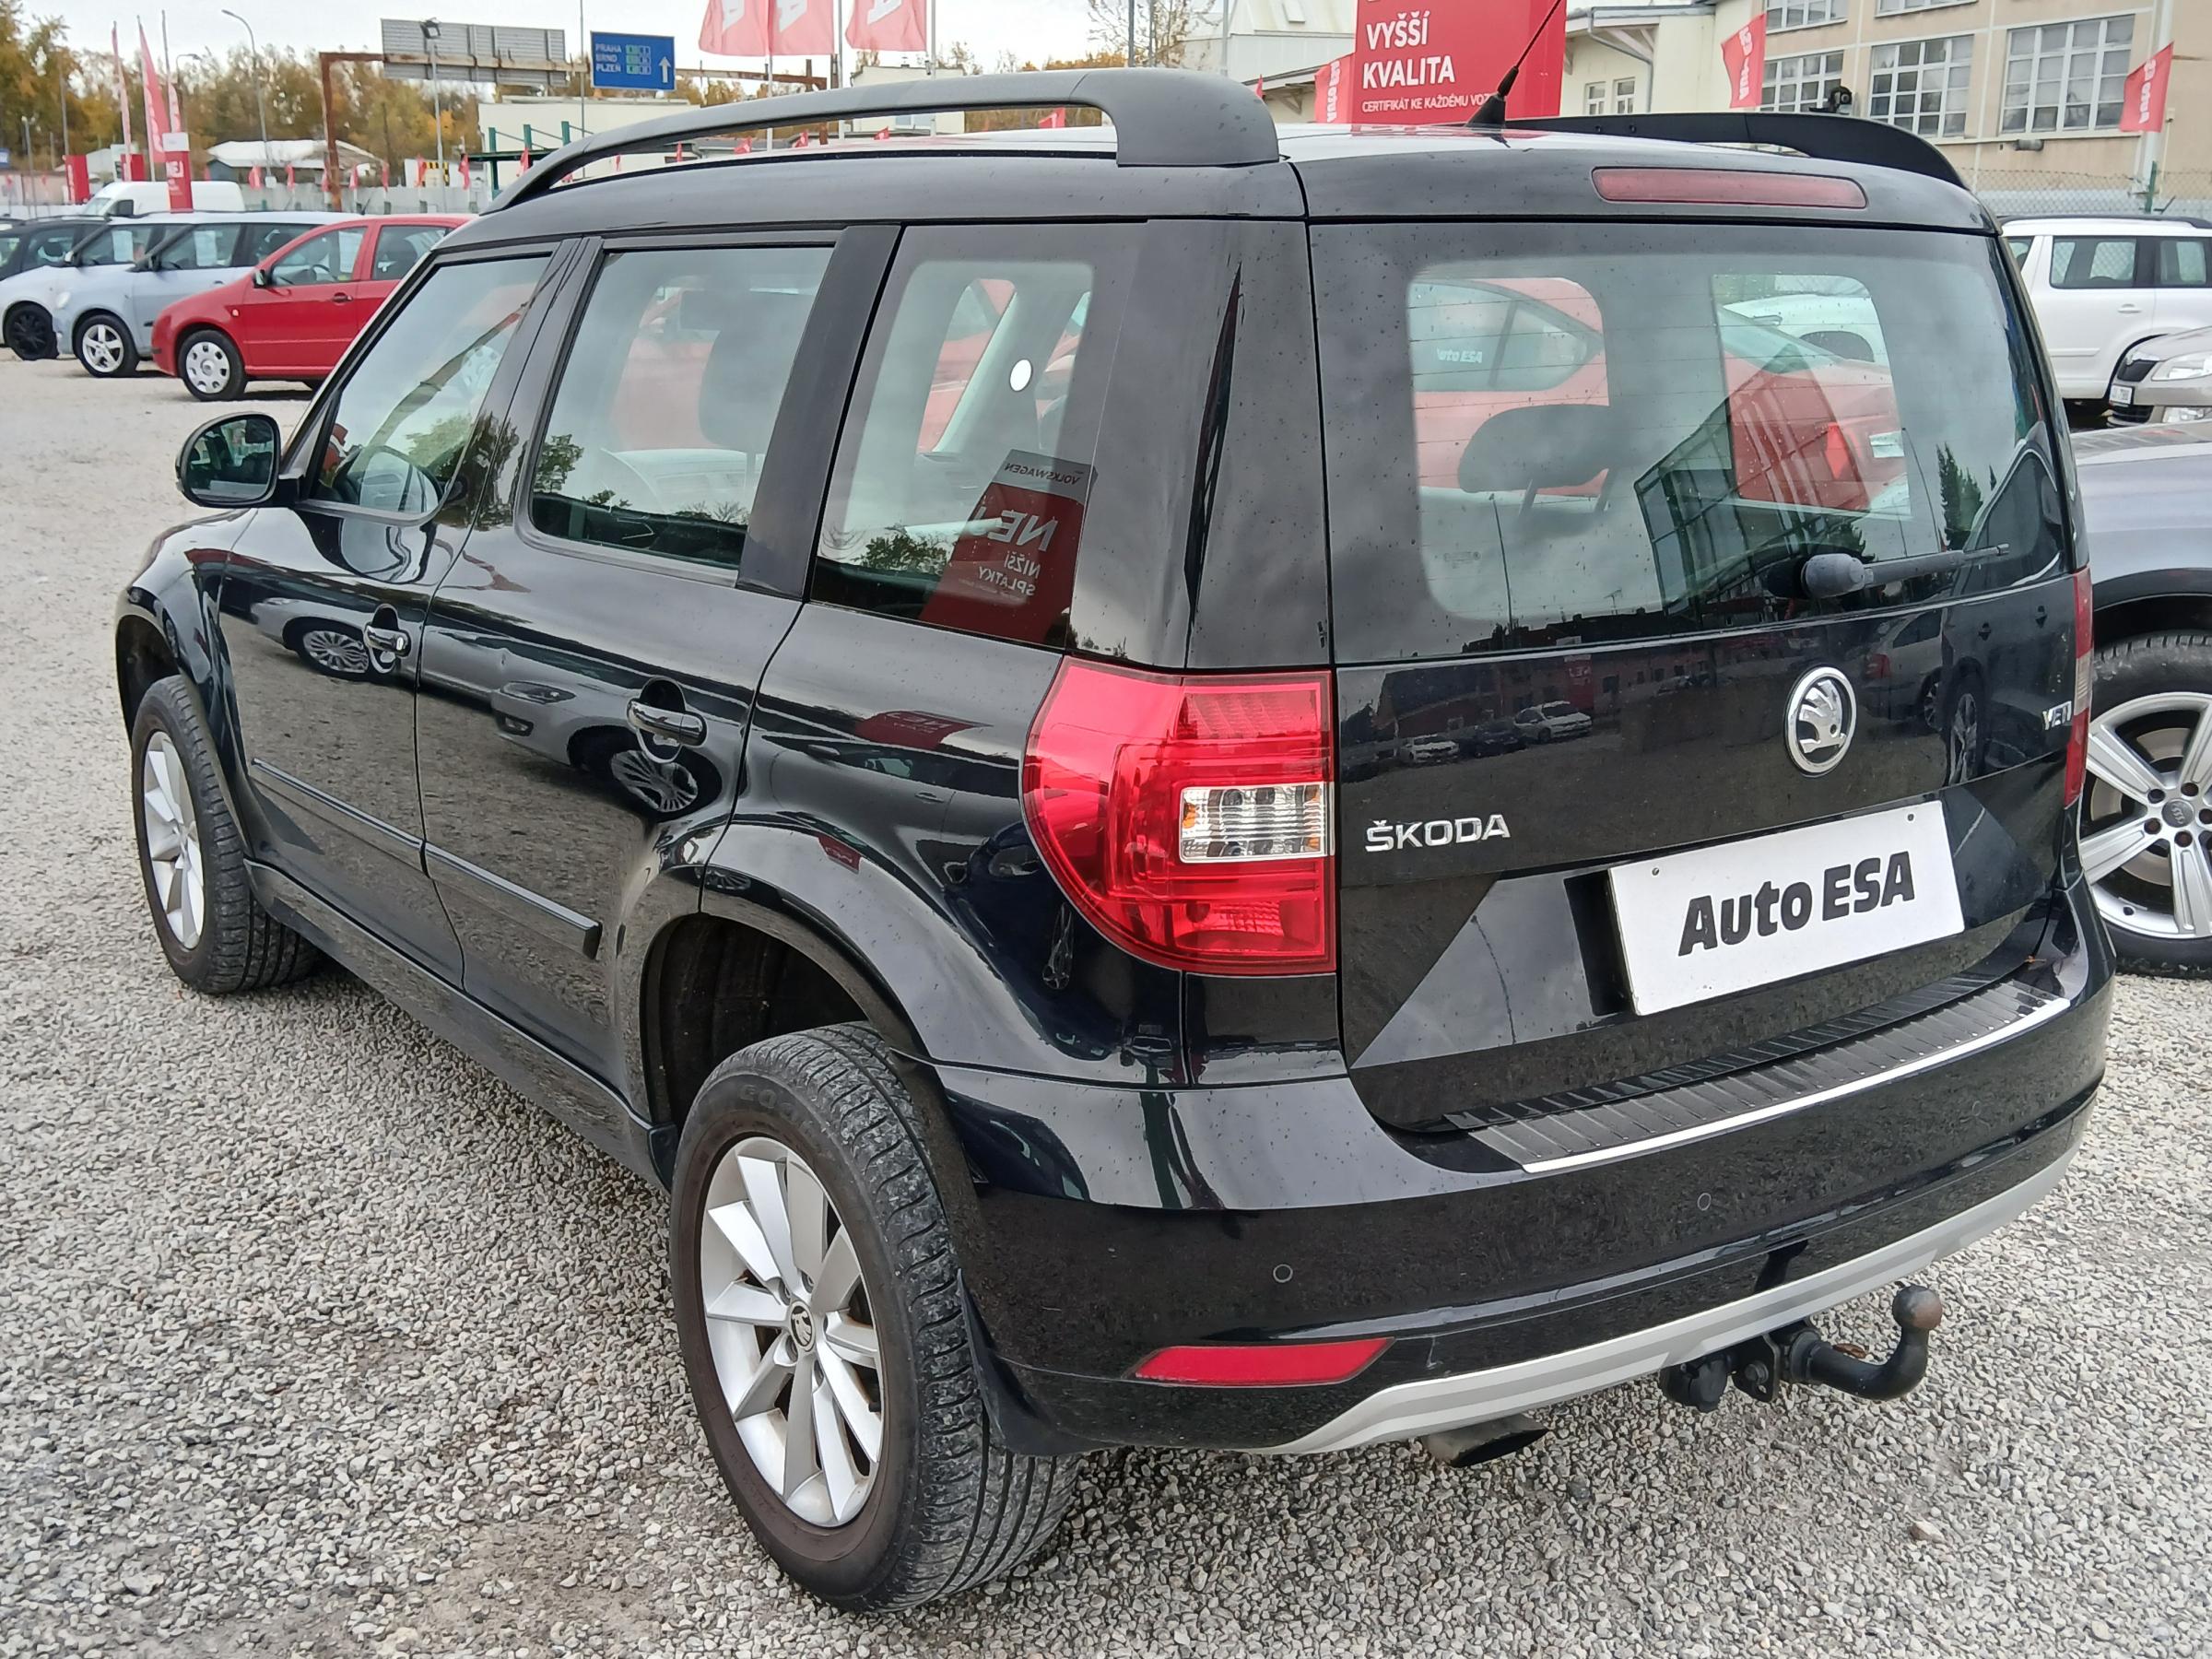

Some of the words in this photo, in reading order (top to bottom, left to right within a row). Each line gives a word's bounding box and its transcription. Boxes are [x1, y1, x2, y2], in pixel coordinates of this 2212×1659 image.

[595, 43, 621, 53] PRAHA
[1366, 10, 1430, 50] VYŠŠÍ
[1362, 56, 1455, 89] KVALITA
[1361, 98, 1409, 112] CERTIFIKÁT
[1410, 99, 1422, 110] KE
[1423, 94, 1468, 109] KAŽDÉMU
[1471, 93, 1490, 106] VOZ
[1365, 814, 1511, 853] ŠKODA
[1677, 880, 1813, 957] Auto
[1822, 851, 1915, 922] ESA
